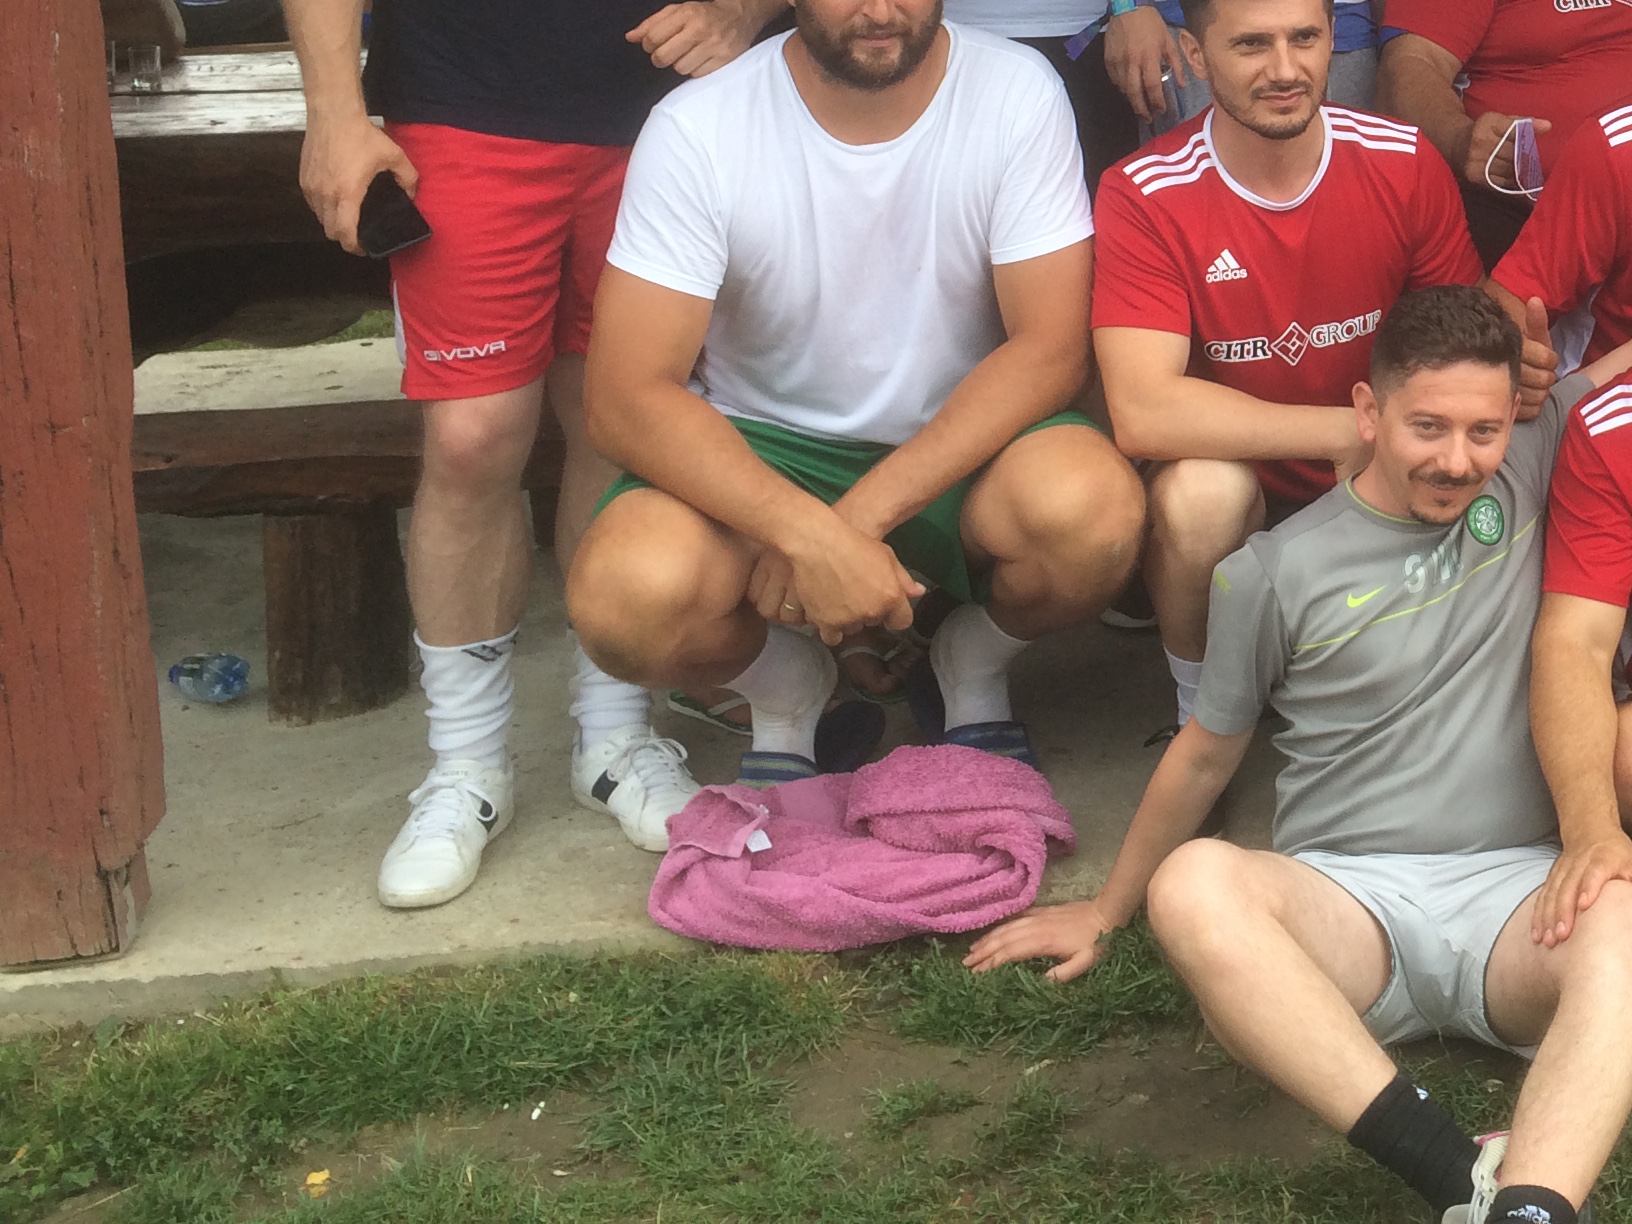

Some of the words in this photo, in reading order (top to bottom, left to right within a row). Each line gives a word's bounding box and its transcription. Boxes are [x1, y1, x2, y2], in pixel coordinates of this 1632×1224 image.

[1206, 268, 1247, 284] adidas
[1205, 337, 1272, 362] CITR
[1310, 310, 1381, 347] GROUP
